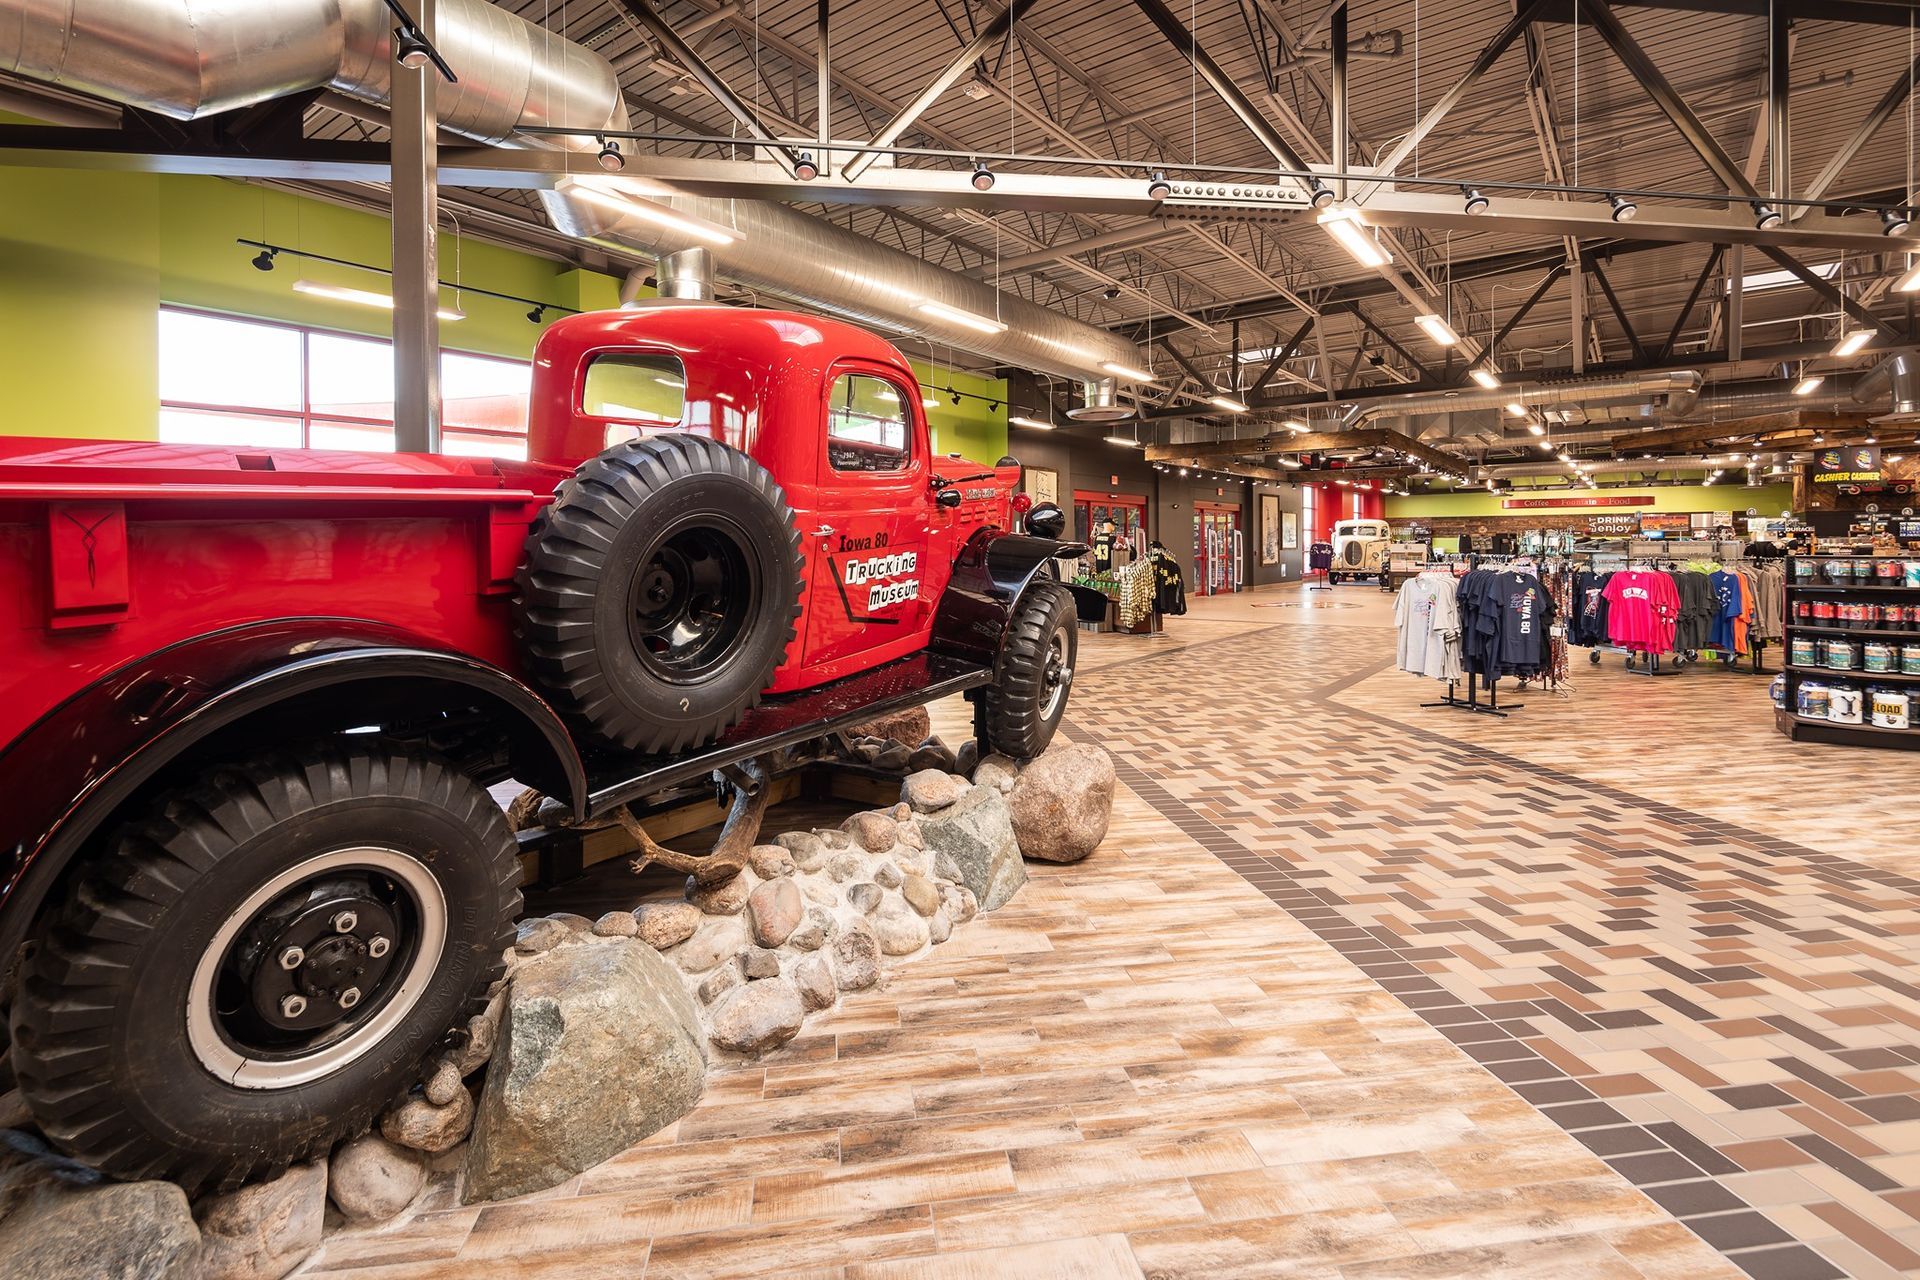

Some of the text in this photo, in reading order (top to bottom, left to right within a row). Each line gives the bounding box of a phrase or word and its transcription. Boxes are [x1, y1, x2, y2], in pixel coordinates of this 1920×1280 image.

[1814, 473, 1850, 482] CASHIER
[1851, 472, 1880, 481] CASHIER
[1608, 497, 1631, 505] Food
[1597, 516, 1631, 524] DRINK
[1597, 525, 1632, 534] enjoy
[839, 532, 889, 553] Iowa 80
[1095, 544, 1109, 560] 43
[1520, 621, 1531, 634] 80
[1876, 704, 1900, 714] LOAD
